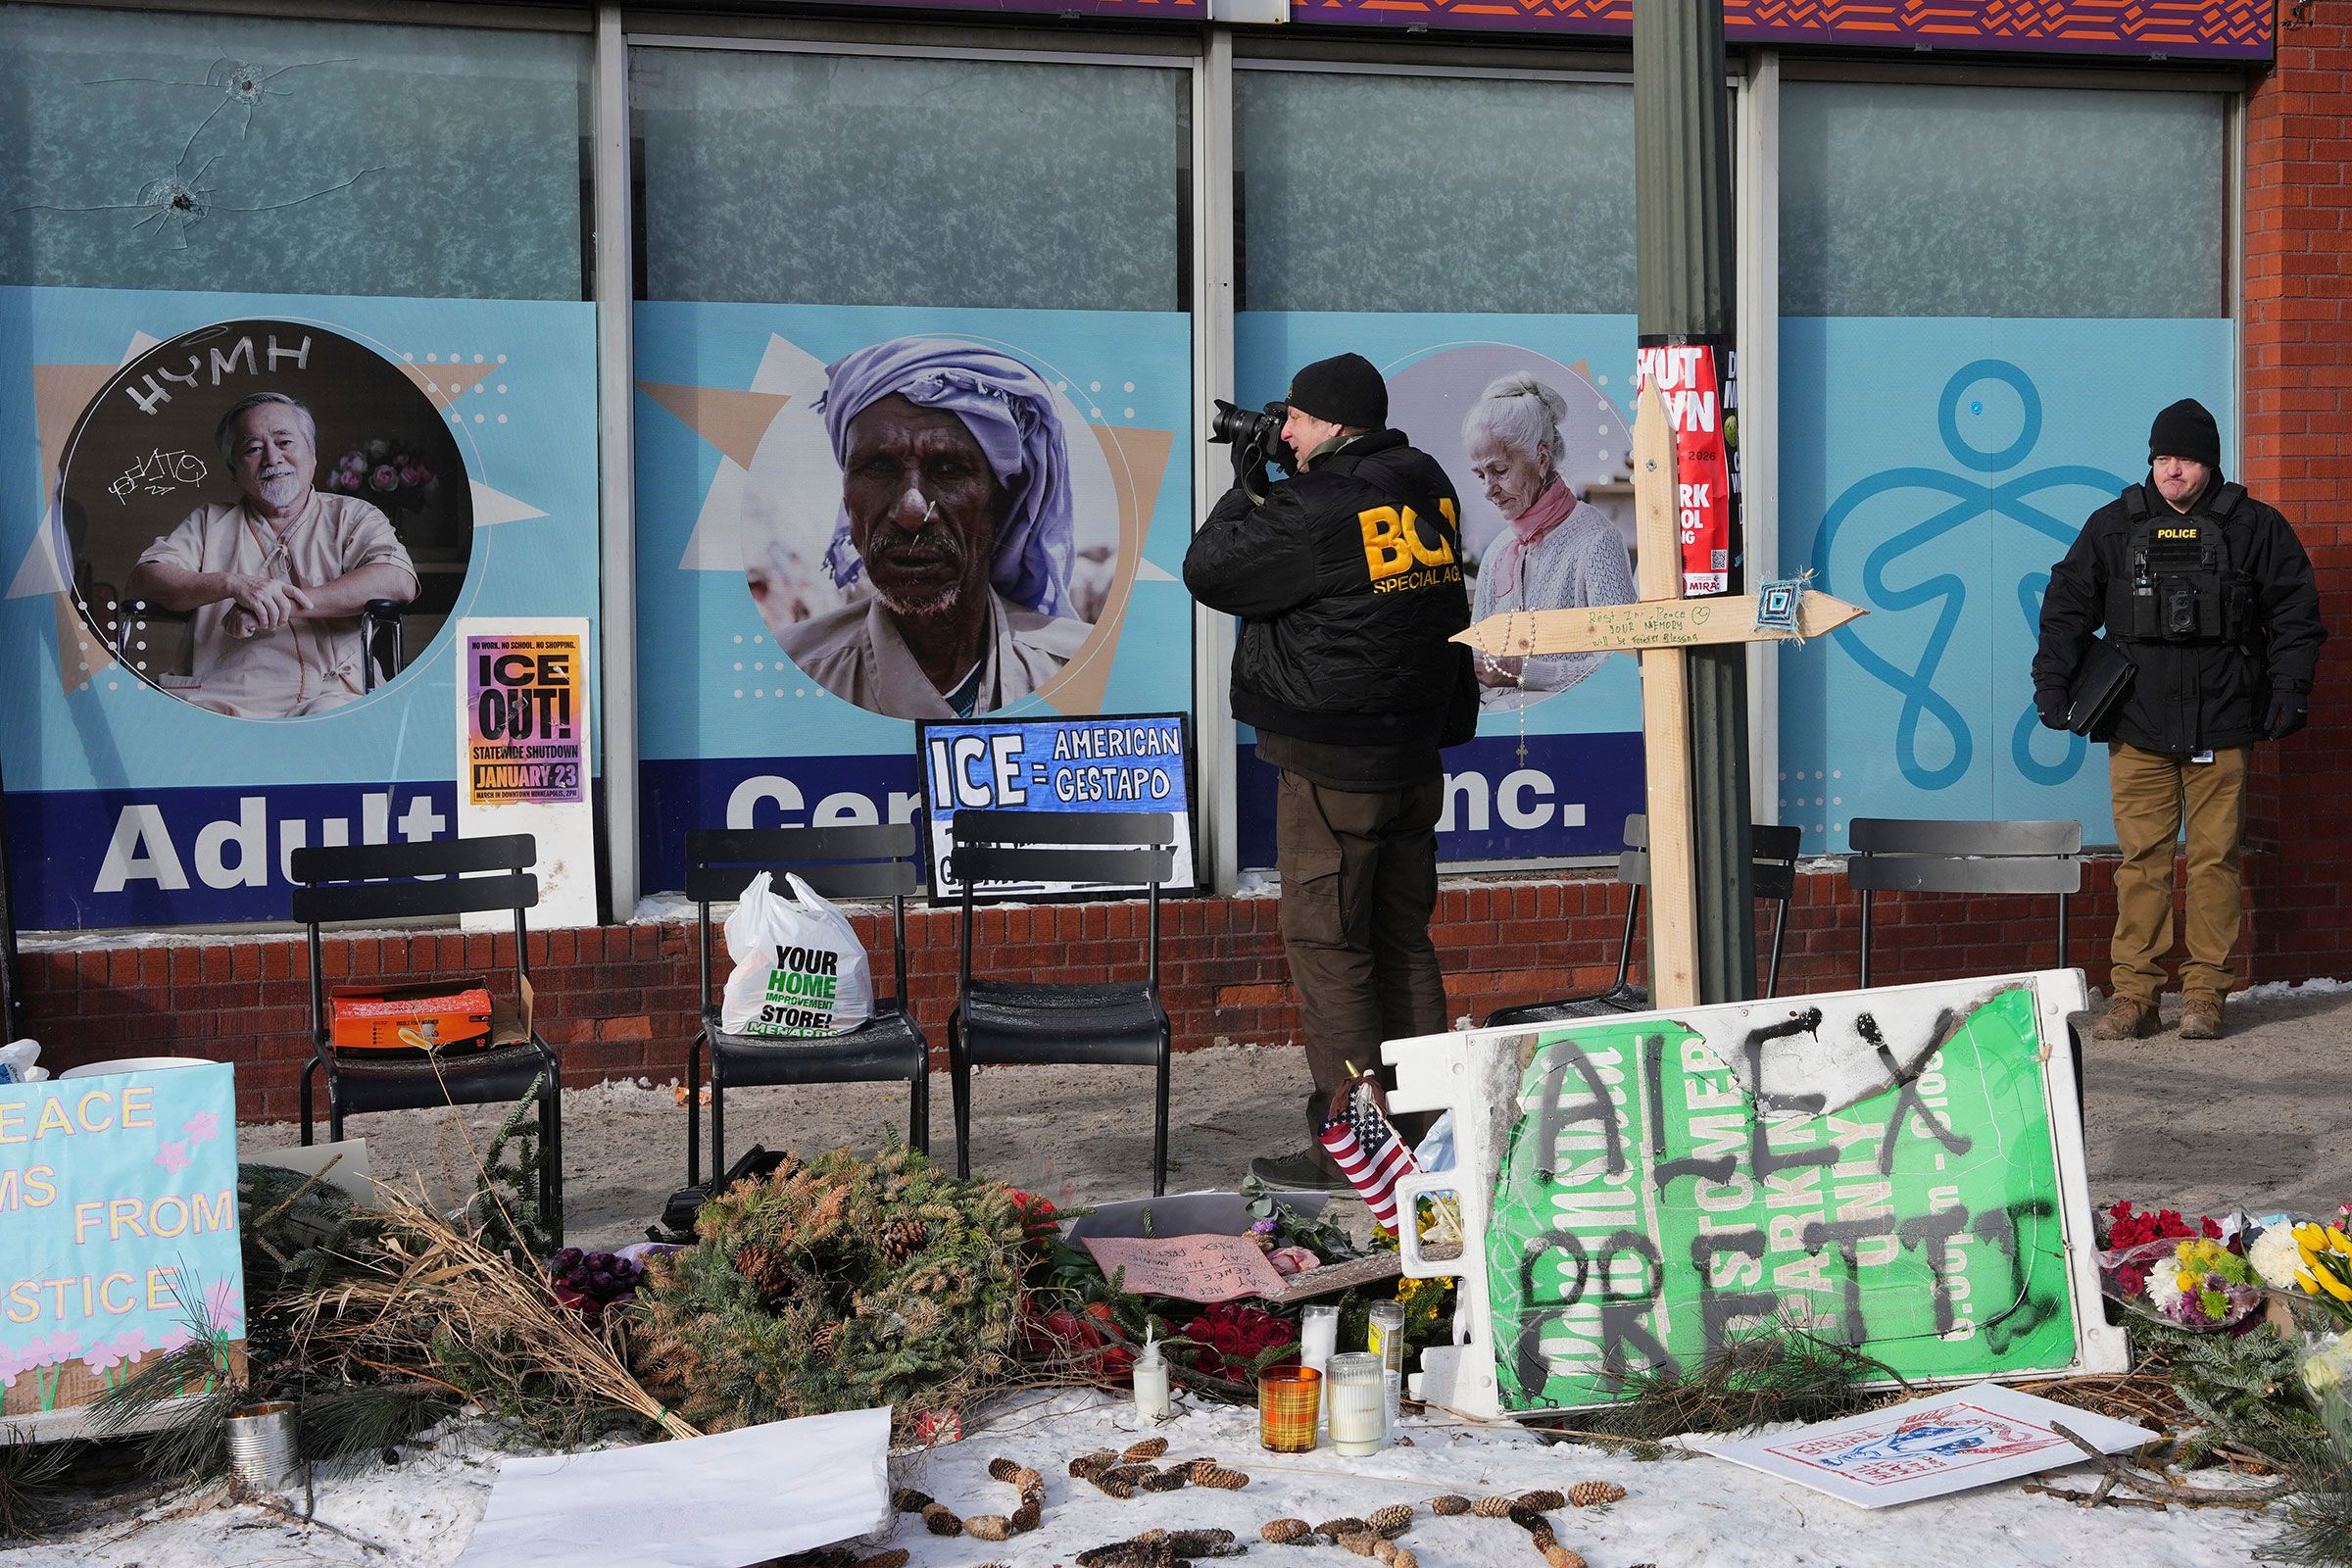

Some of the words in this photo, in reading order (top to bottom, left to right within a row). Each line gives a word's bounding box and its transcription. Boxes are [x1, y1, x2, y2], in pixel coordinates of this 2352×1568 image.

[1637, 348, 1702, 390] HUT
[1689, 452, 1716, 461] 2026
[2158, 529, 2196, 539] POLICE
[1373, 568, 1440, 594] SPECIAL
[1589, 611, 1615, 623] Rest
[1656, 607, 1686, 619] Peace
[1644, 619, 1683, 631] MEMORY
[1592, 636, 1608, 647] will
[1617, 636, 1626, 645] be
[479, 655, 569, 686] ICE
[479, 688, 570, 741] OUT!
[473, 746, 524, 760] STATEWIDE
[526, 745, 578, 759] SHUTDOWN
[928, 734, 1029, 809] ICE
[1053, 727, 1182, 760] AMERICAN
[476, 765, 551, 788] JANUARY
[555, 764, 576, 787] 23
[1055, 766, 1171, 803] GESTAPO
[1435, 769, 1586, 832] nc.
[93, 793, 446, 893] Adult
[776, 945, 838, 976] YOUR
[767, 969, 838, 1000] HOME
[760, 1004, 832, 1029] STORE!
[765, 992, 834, 1010] IMPROVEMENT
[0, 1086, 155, 1145] EACE
[1532, 1007, 1972, 1203] ALEX
[1826, 1114, 1899, 1267] ONLY
[74, 1189, 234, 1245] FROM
[0, 1266, 181, 1323] STICE
[1517, 1198, 2058, 1402] PRETTI
